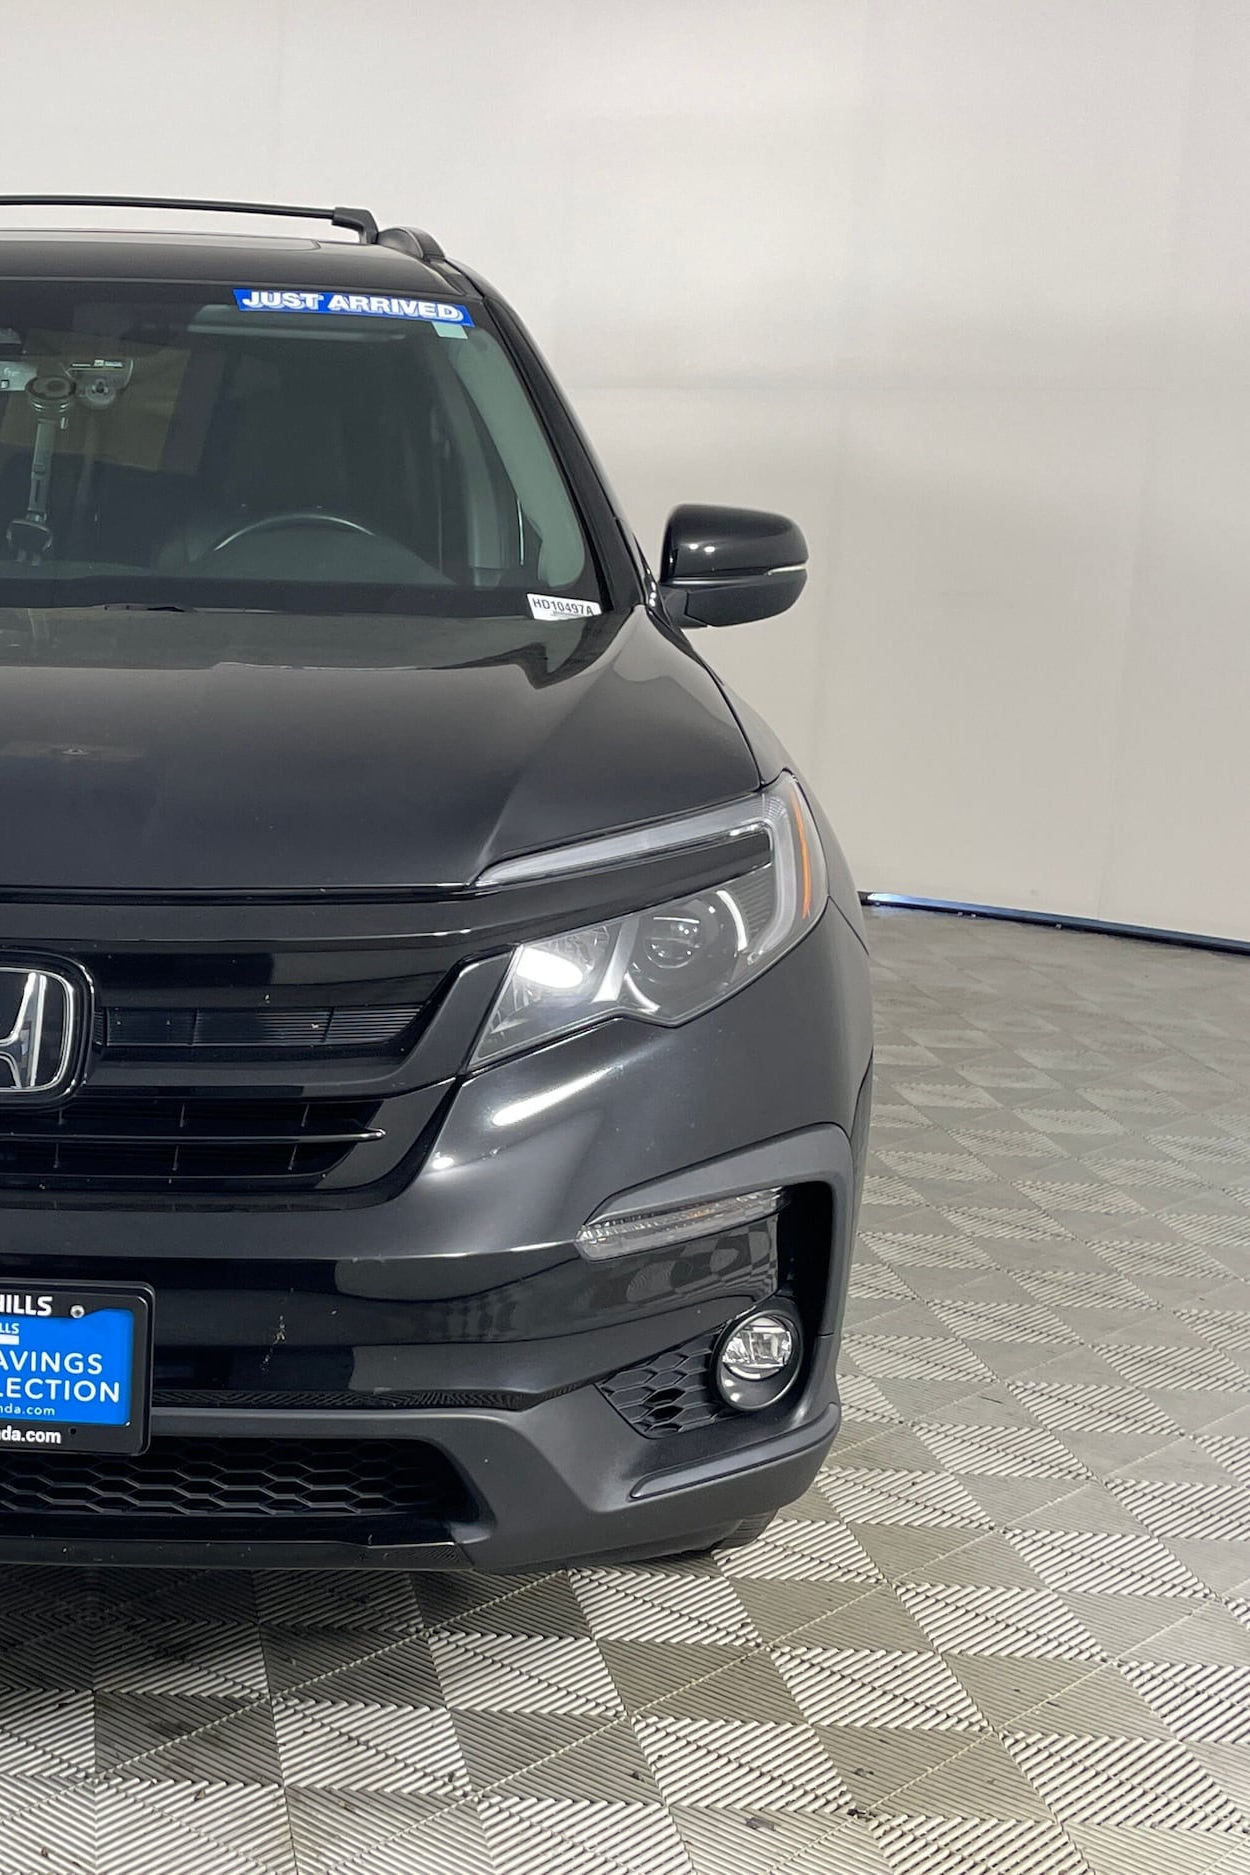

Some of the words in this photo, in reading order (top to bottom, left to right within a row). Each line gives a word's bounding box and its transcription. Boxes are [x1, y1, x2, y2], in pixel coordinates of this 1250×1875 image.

[241, 291, 324, 309] JUST
[328, 295, 464, 321] ARRIVED
[532, 598, 594, 616] HD10497A
